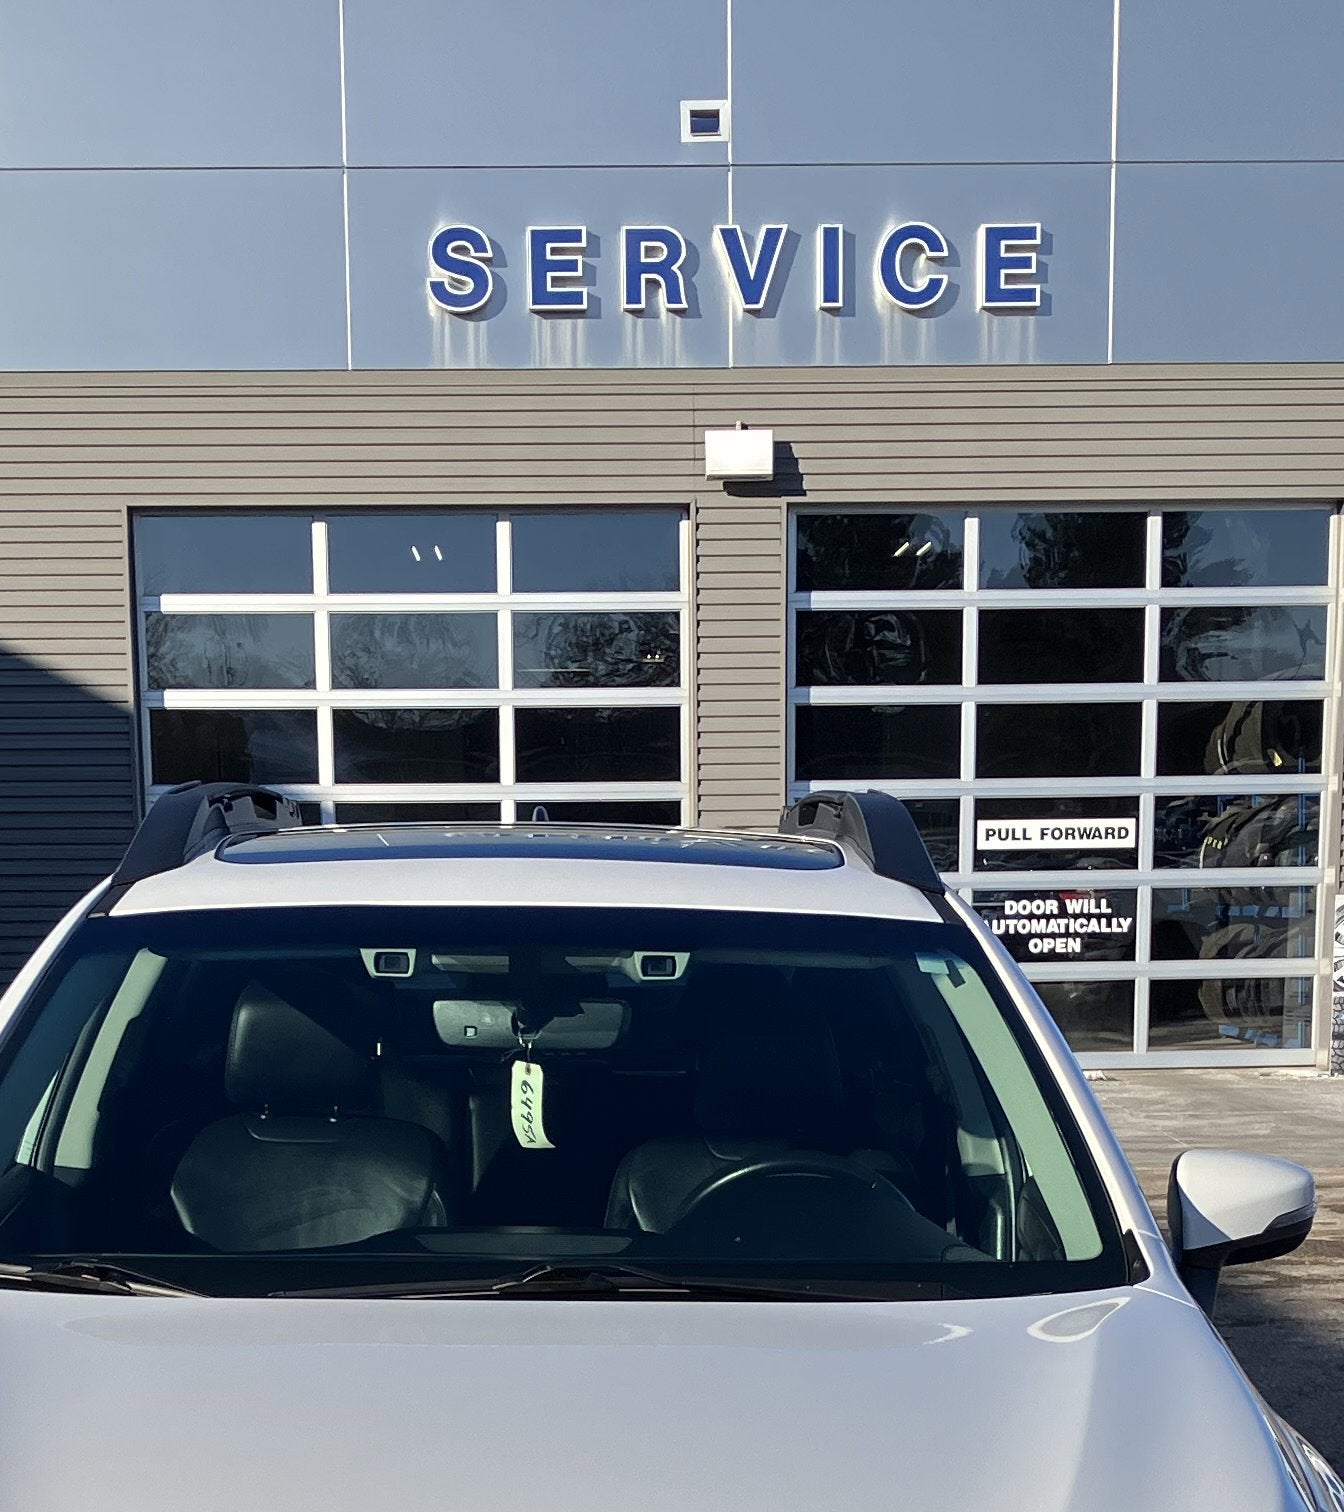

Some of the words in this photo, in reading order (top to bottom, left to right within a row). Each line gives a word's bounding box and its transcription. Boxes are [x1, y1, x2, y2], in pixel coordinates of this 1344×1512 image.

[426, 220, 1042, 313] SERVICE
[984, 827, 1032, 842] PULL
[1040, 826, 1130, 840] FORWARD
[1004, 899, 1058, 915] DOOR
[1065, 898, 1112, 914] WILL
[984, 917, 1133, 935] UTOMATICALLY
[1028, 937, 1082, 953] OPEN
